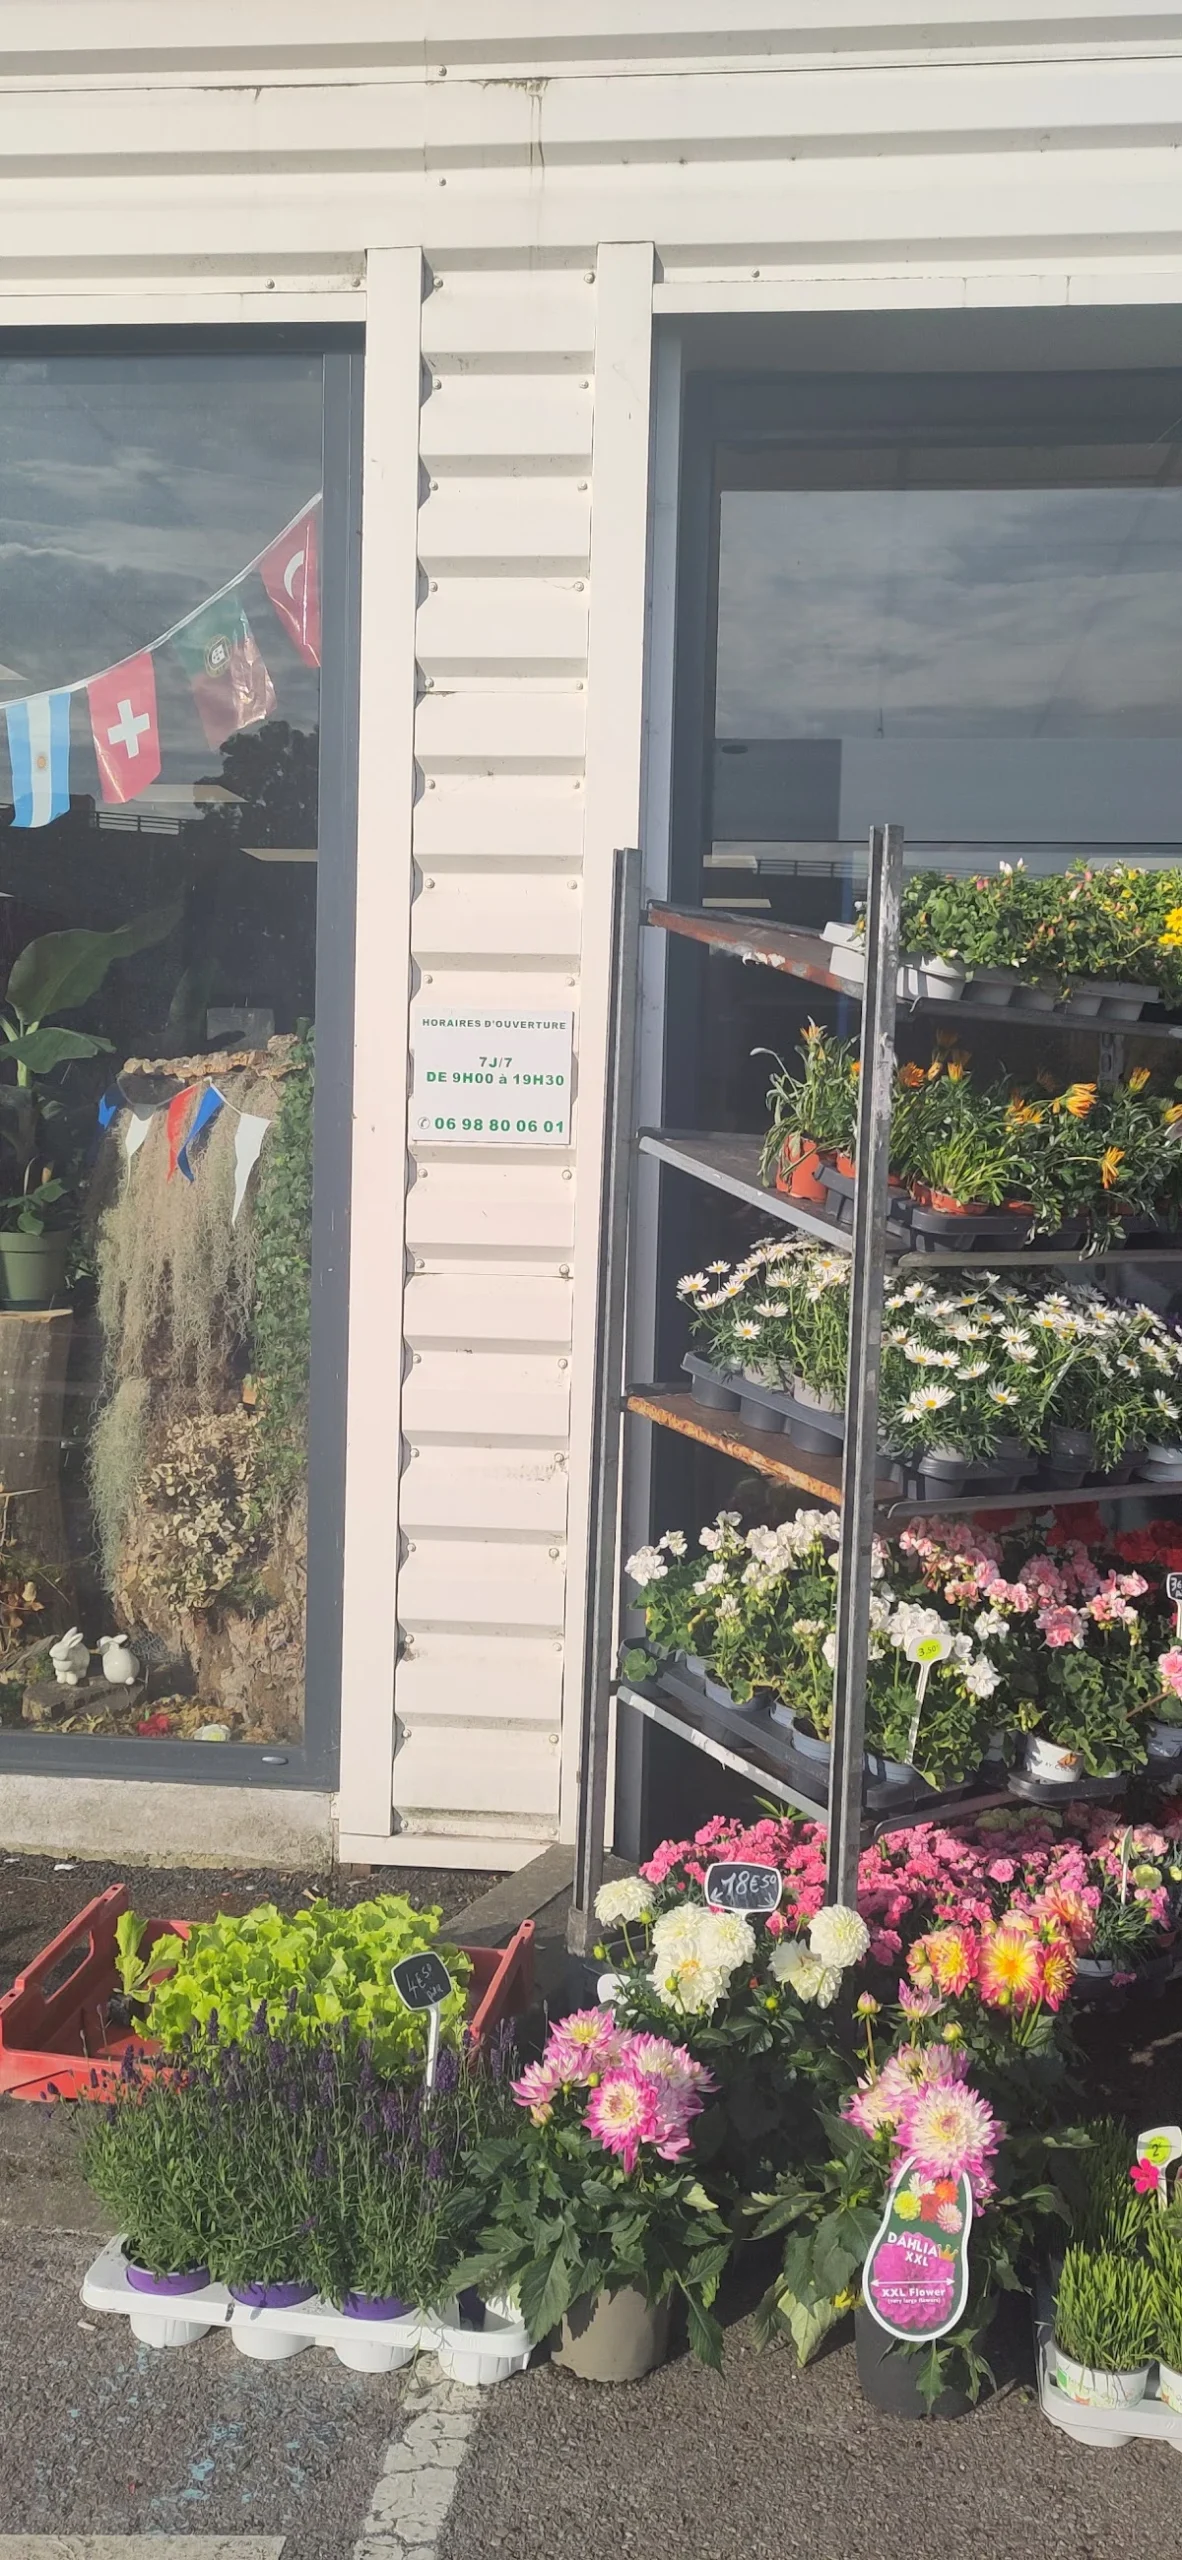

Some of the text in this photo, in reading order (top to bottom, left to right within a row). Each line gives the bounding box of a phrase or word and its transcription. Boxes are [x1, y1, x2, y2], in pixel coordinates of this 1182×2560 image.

[422, 1019, 566, 1029] HORAIRES D'OUVERTURE
[479, 1057, 513, 1068] 7J/7
[426, 1072, 564, 1086] DE 9H00 à 19H30
[434, 1118, 564, 1133] 06 98 80 06 01
[887, 2232, 938, 2257] DAHLIA
[905, 2250, 929, 2267] XXL
[882, 2288, 946, 2297] XXL Flower
